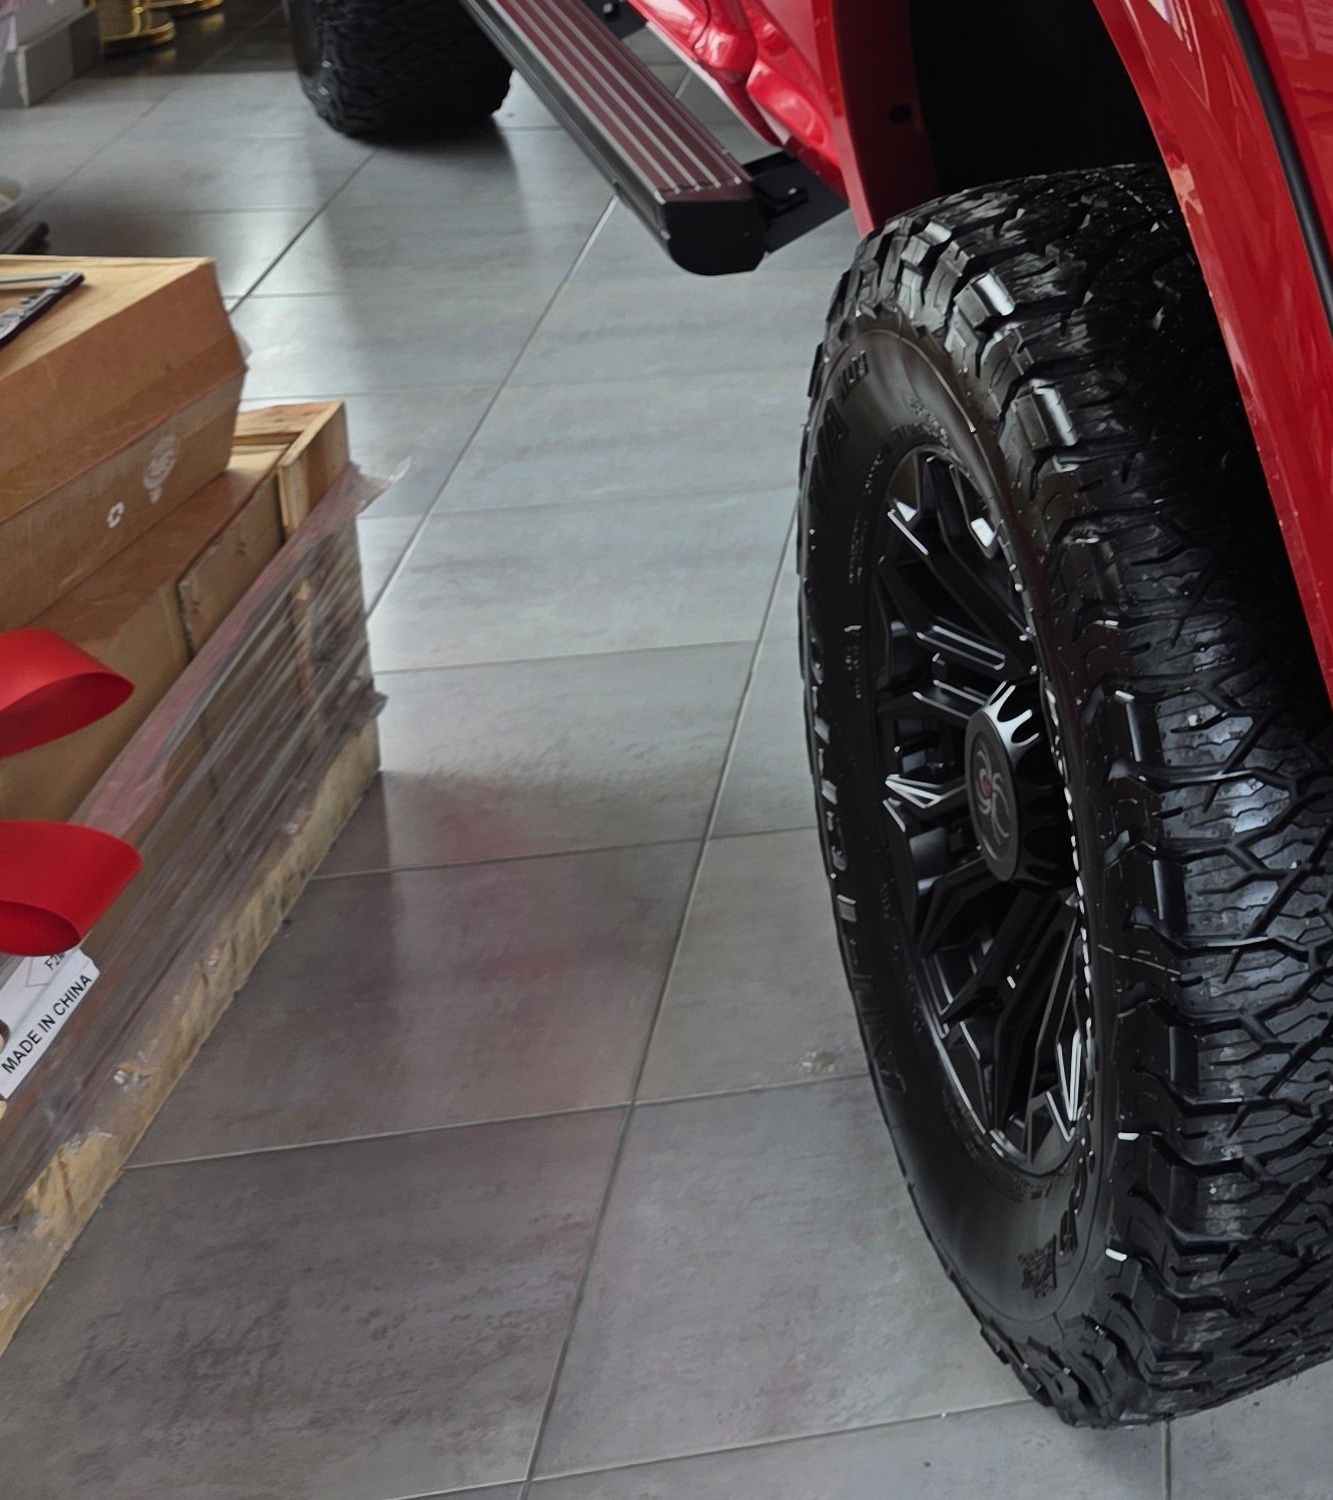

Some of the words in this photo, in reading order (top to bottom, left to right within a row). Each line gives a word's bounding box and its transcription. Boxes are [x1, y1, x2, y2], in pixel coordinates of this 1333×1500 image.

[1, 1028, 44, 1075] MADE
[37, 1013, 57, 1034] IN
[52, 973, 92, 1017] CHINA
